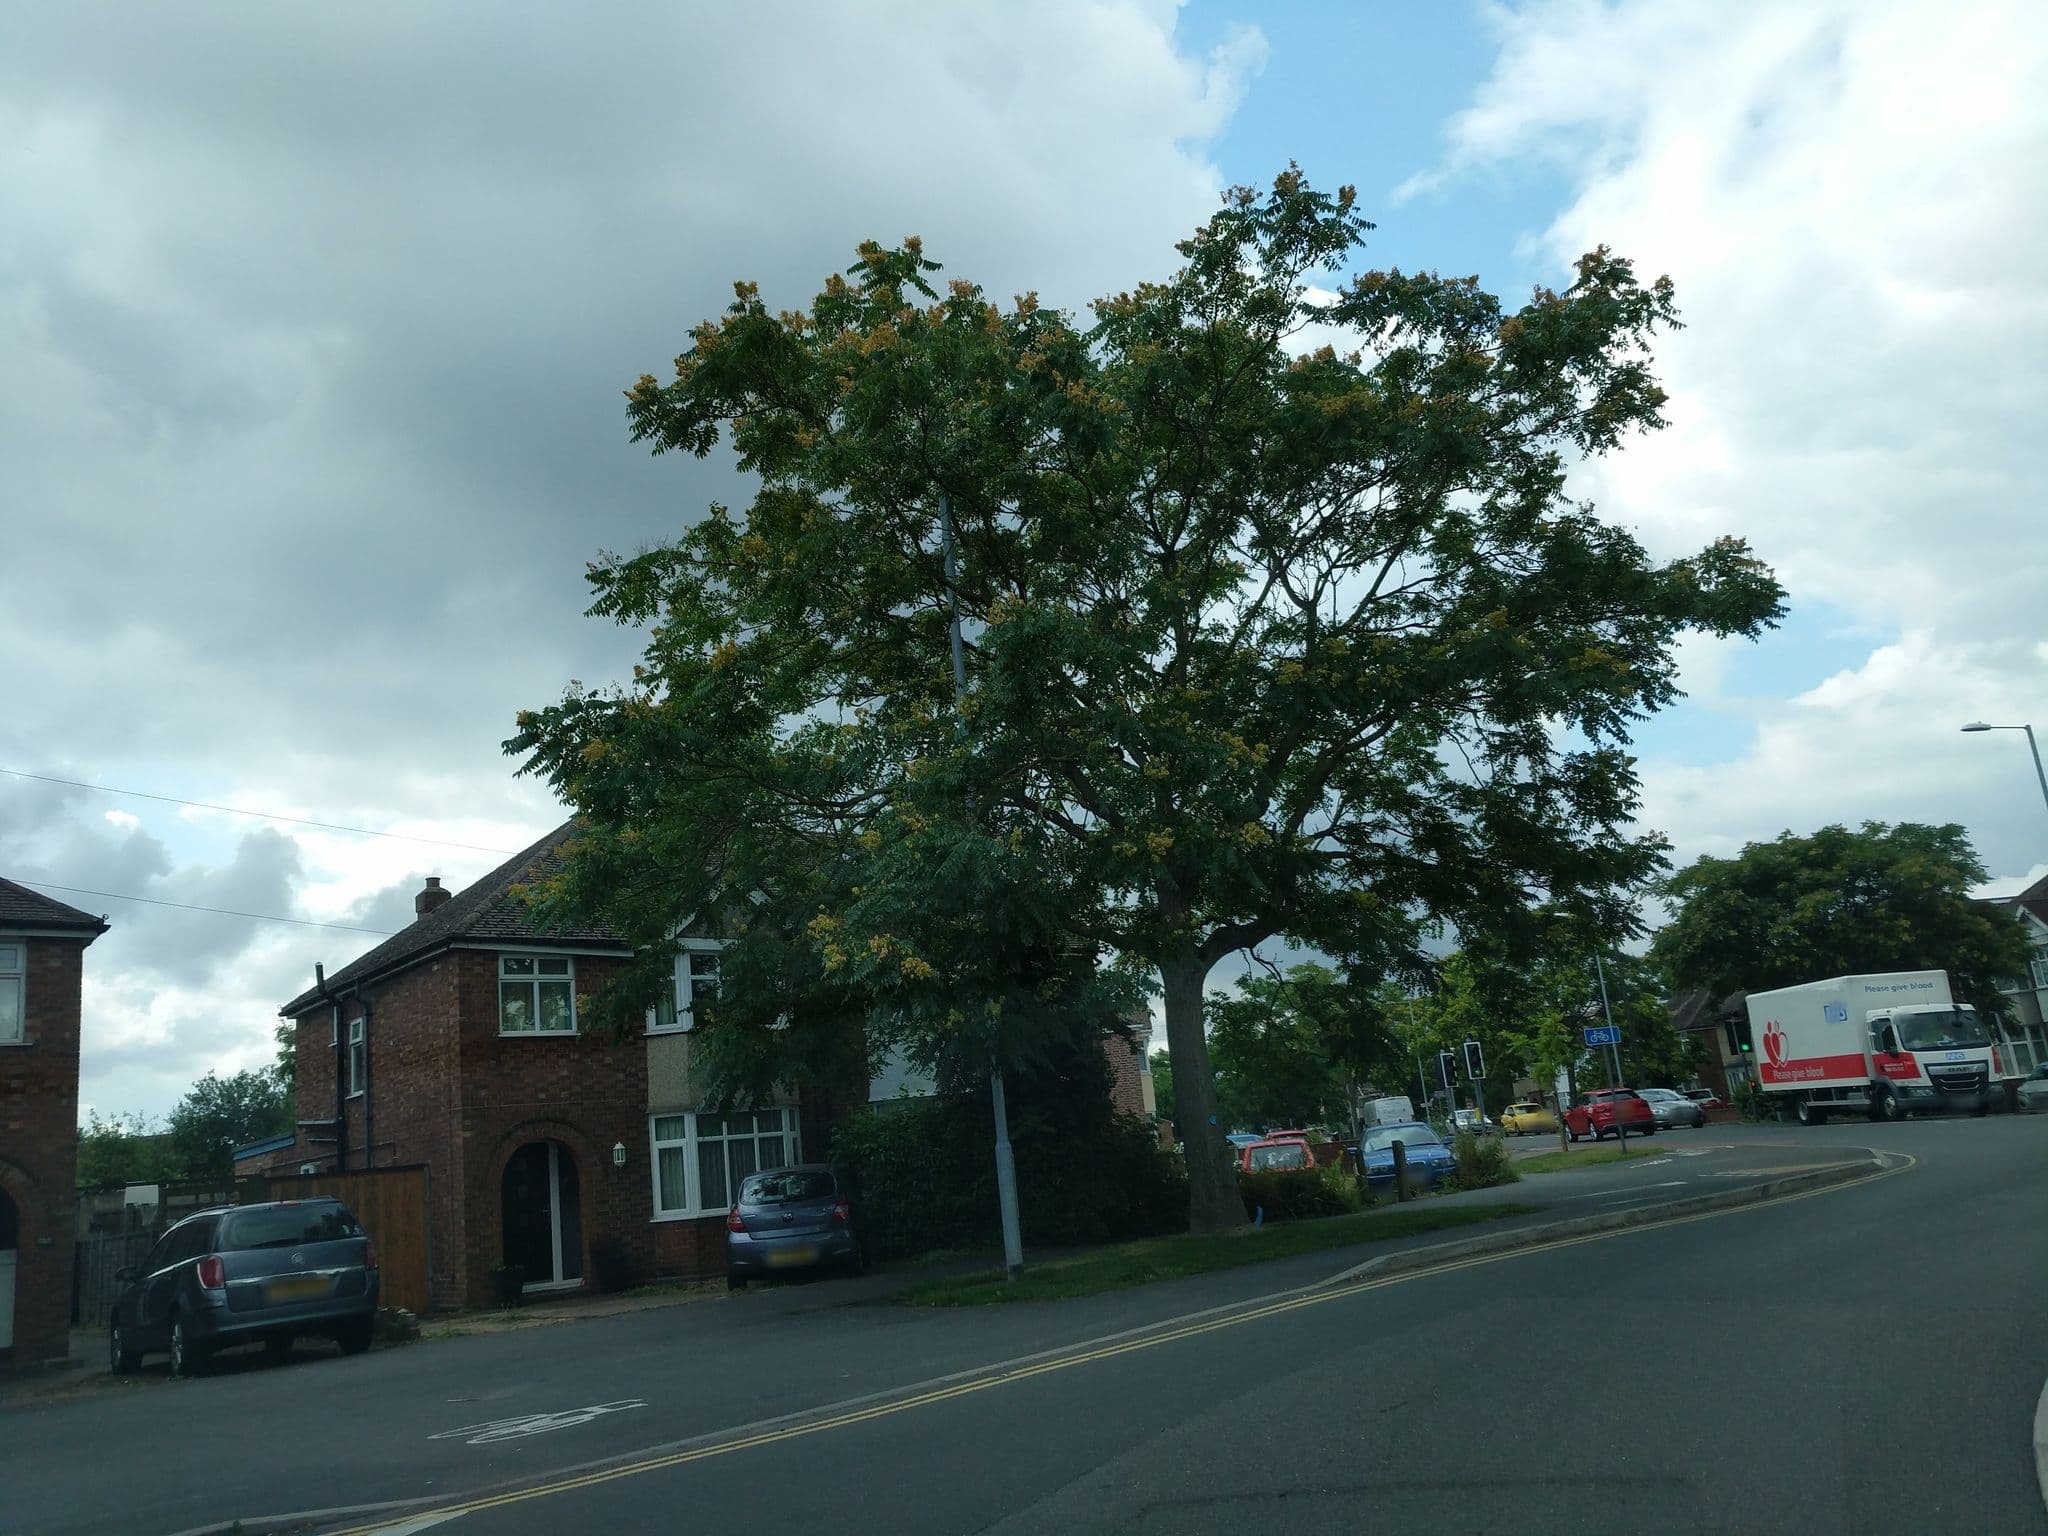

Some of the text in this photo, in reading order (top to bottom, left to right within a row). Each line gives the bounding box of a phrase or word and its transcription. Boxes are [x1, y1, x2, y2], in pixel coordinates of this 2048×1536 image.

[1864, 981, 1933, 993] Please give blood
[1773, 1065, 1824, 1081] Please give blood
